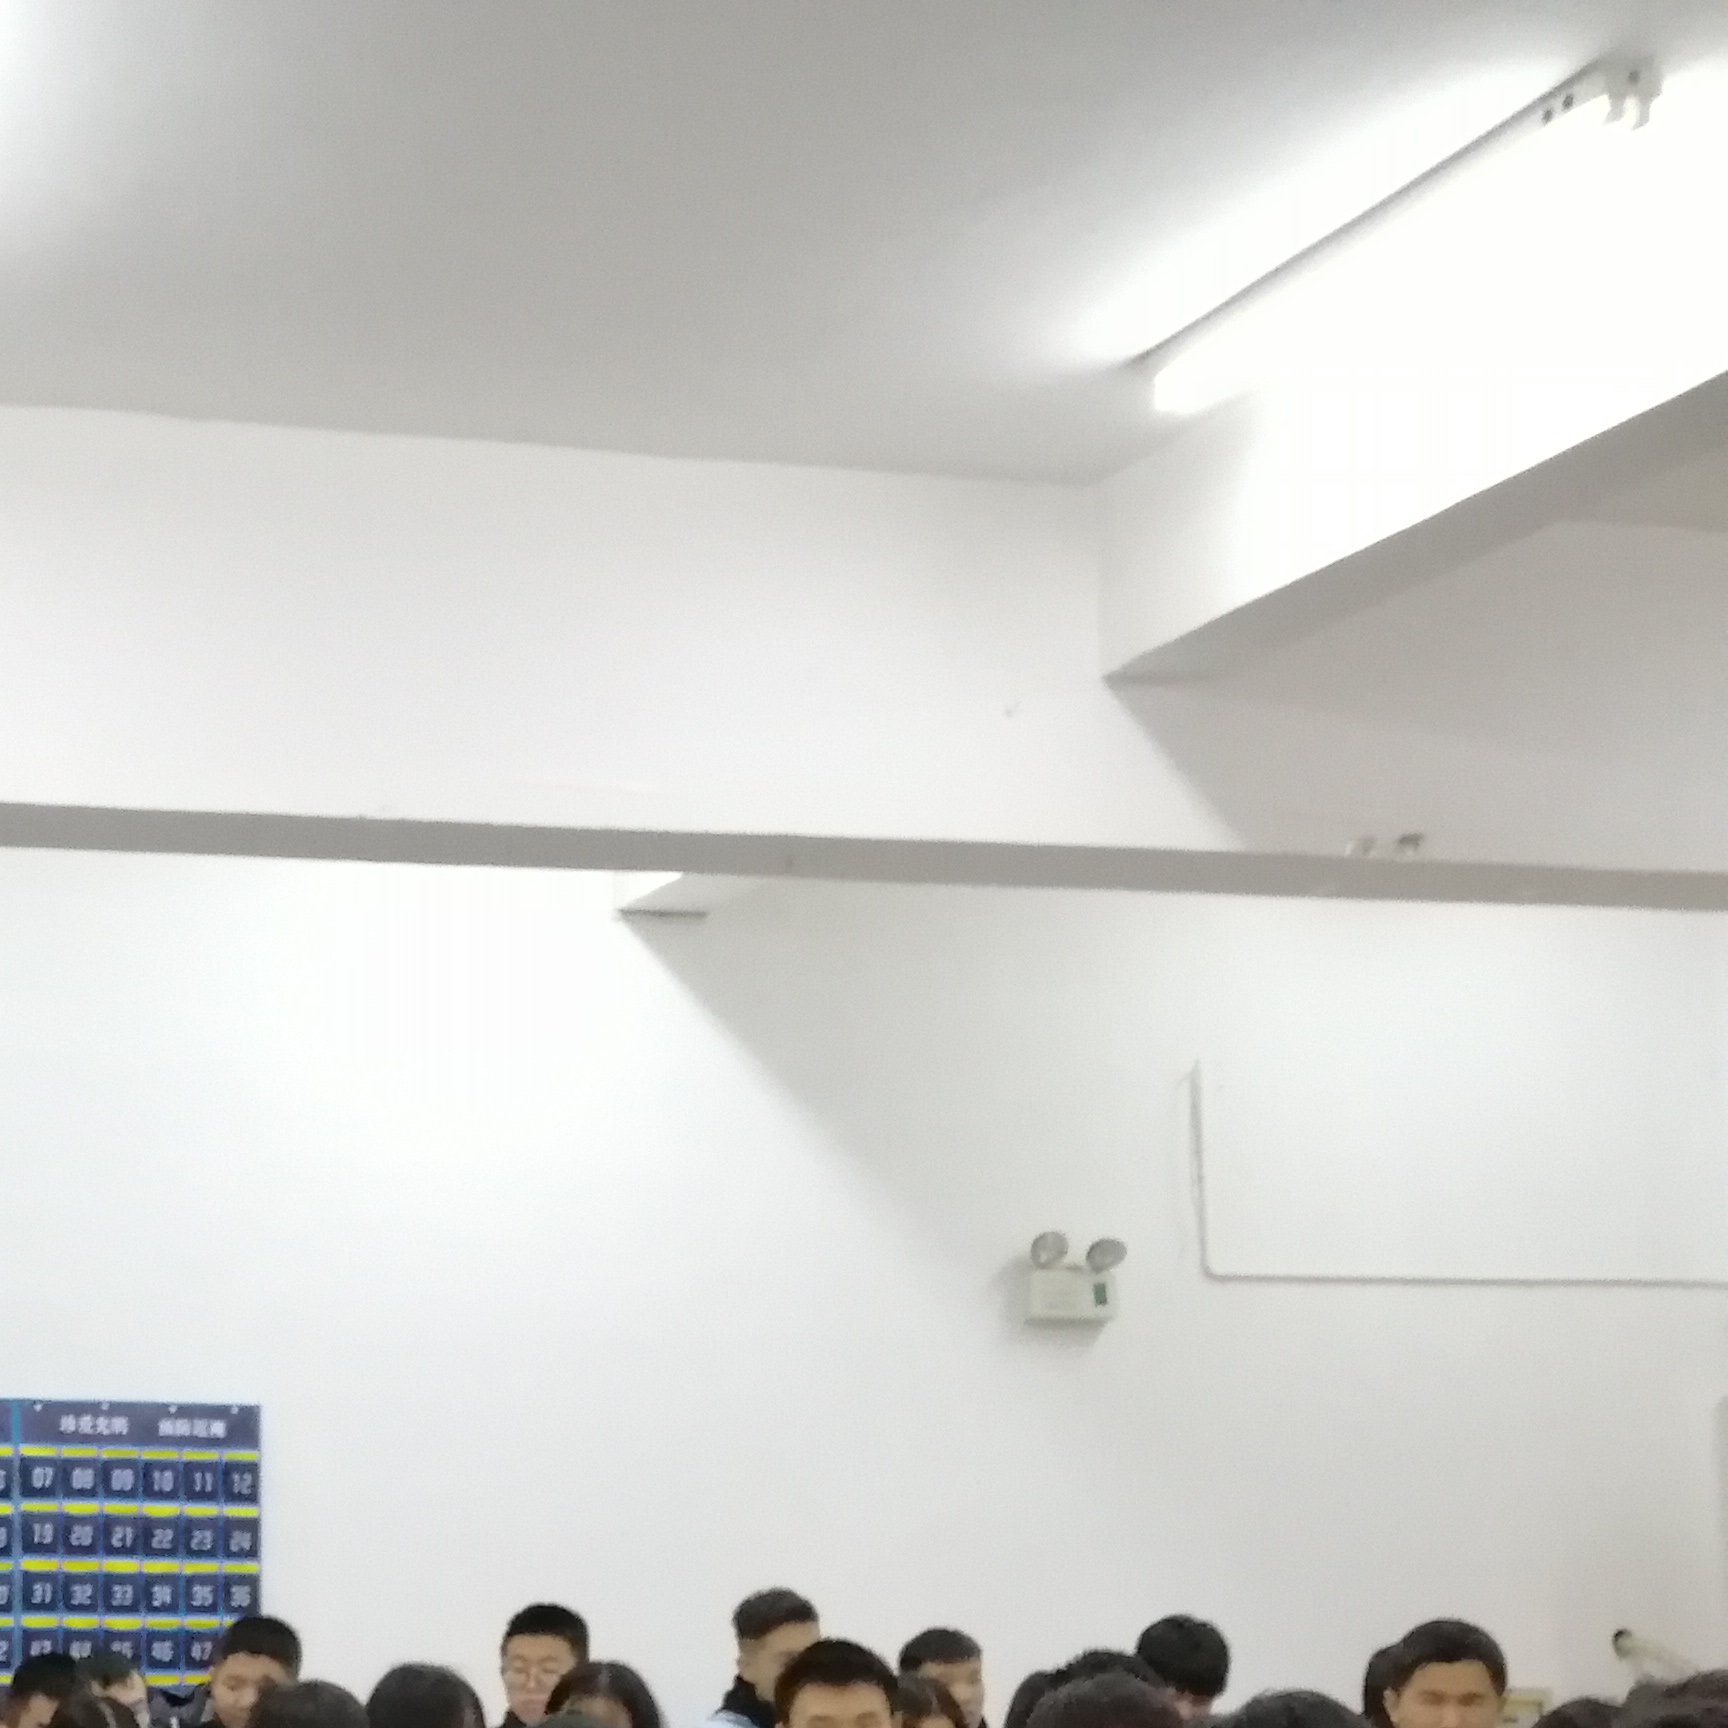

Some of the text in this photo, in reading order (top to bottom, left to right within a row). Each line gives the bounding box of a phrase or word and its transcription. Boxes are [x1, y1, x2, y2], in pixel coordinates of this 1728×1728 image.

[32, 1467, 54, 1489] 07
[153, 1470, 173, 1491] 10
[193, 1472, 213, 1492] 11
[232, 1471, 252, 1495] 12
[33, 1523, 54, 1544] 19
[70, 1525, 93, 1546] 20
[111, 1525, 134, 1548] 21
[151, 1528, 173, 1549] 22
[191, 1530, 213, 1551] 23
[229, 1529, 252, 1552] 24
[31, 1582, 52, 1604] 31
[71, 1583, 94, 1605] 32
[111, 1584, 134, 1606] 33
[151, 1584, 172, 1607] 34
[191, 1584, 214, 1607] 35
[191, 1641, 213, 1662] 47
